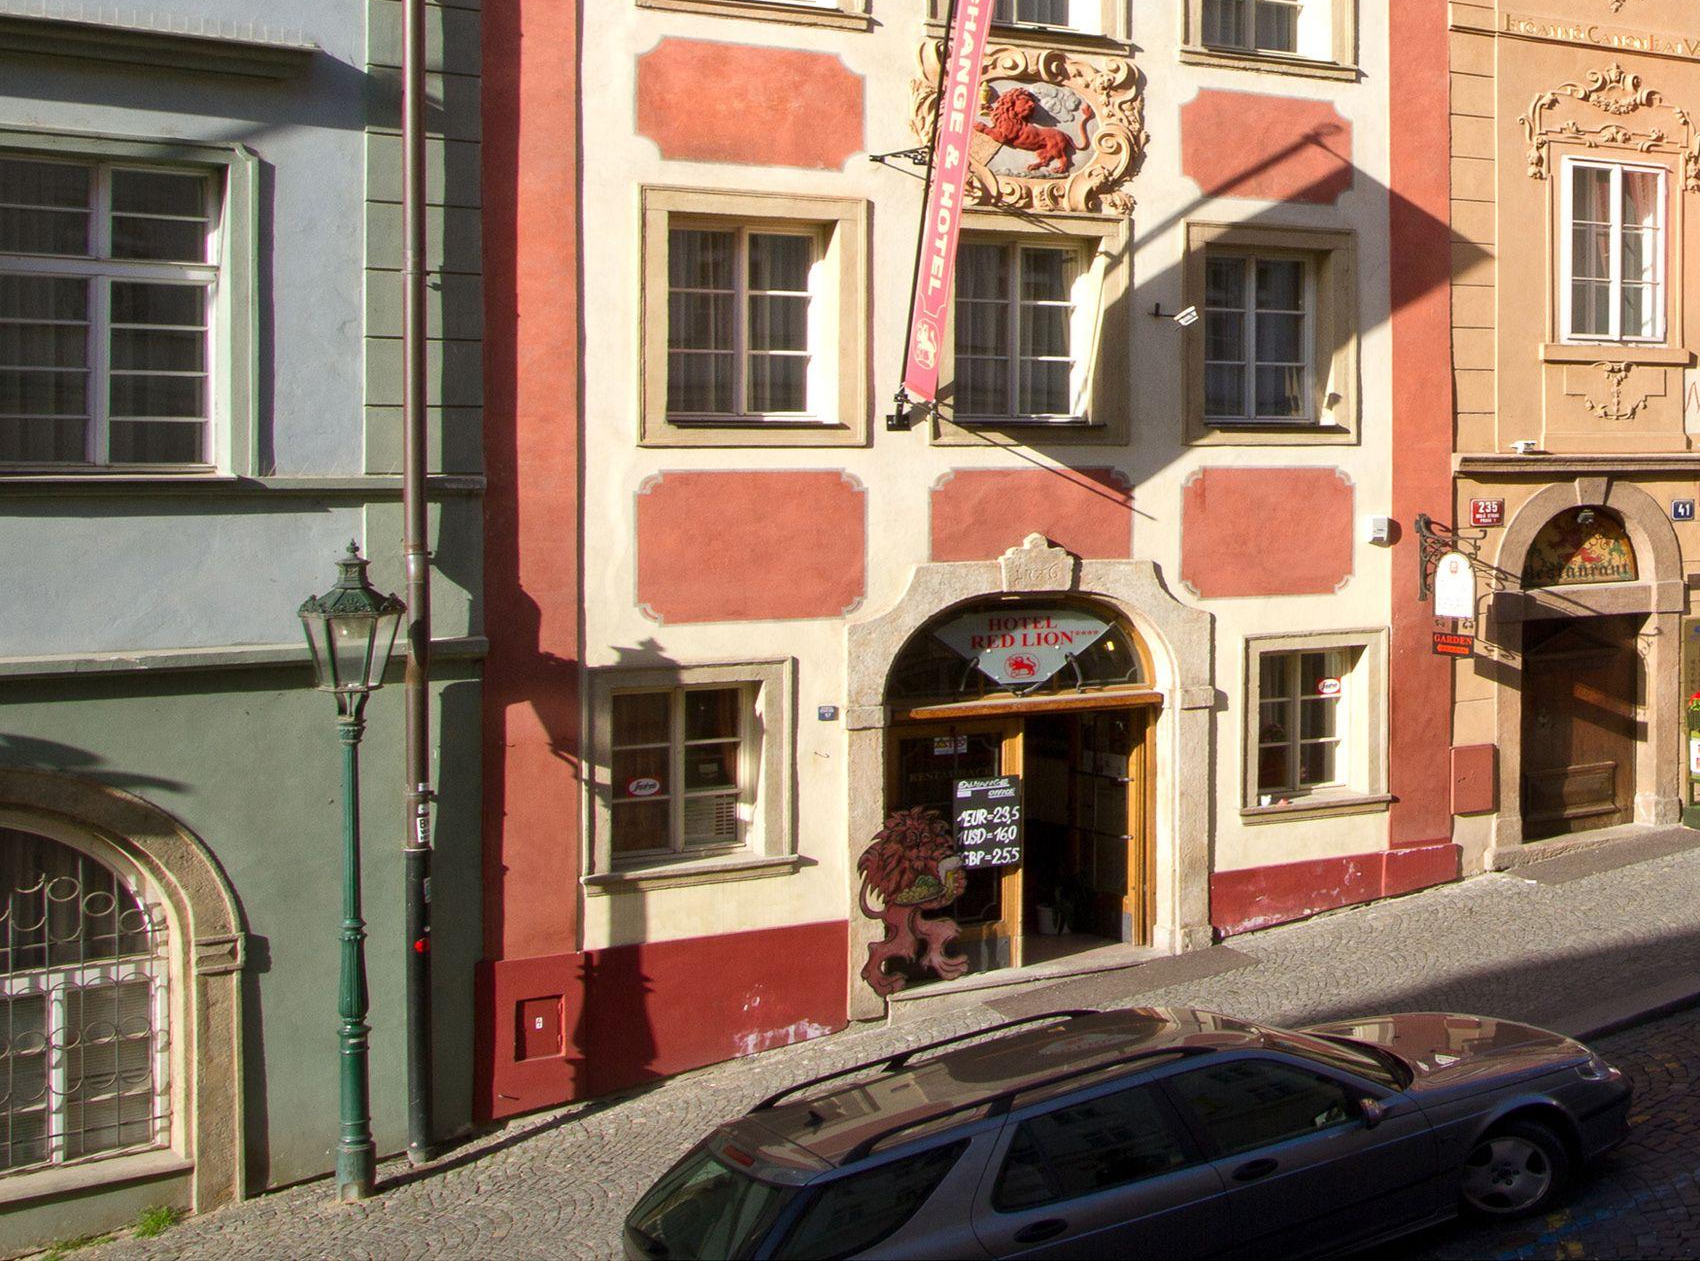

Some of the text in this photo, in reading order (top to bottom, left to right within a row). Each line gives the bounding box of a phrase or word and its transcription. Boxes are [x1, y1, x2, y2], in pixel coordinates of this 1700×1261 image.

[945, 144, 960, 170] &
[928, 181, 955, 295] HOTEL
[1479, 502, 1498, 513] 235
[1678, 503, 1690, 516] 41
[989, 616, 1058, 631] HOTEL
[971, 631, 1073, 649] RED LION
